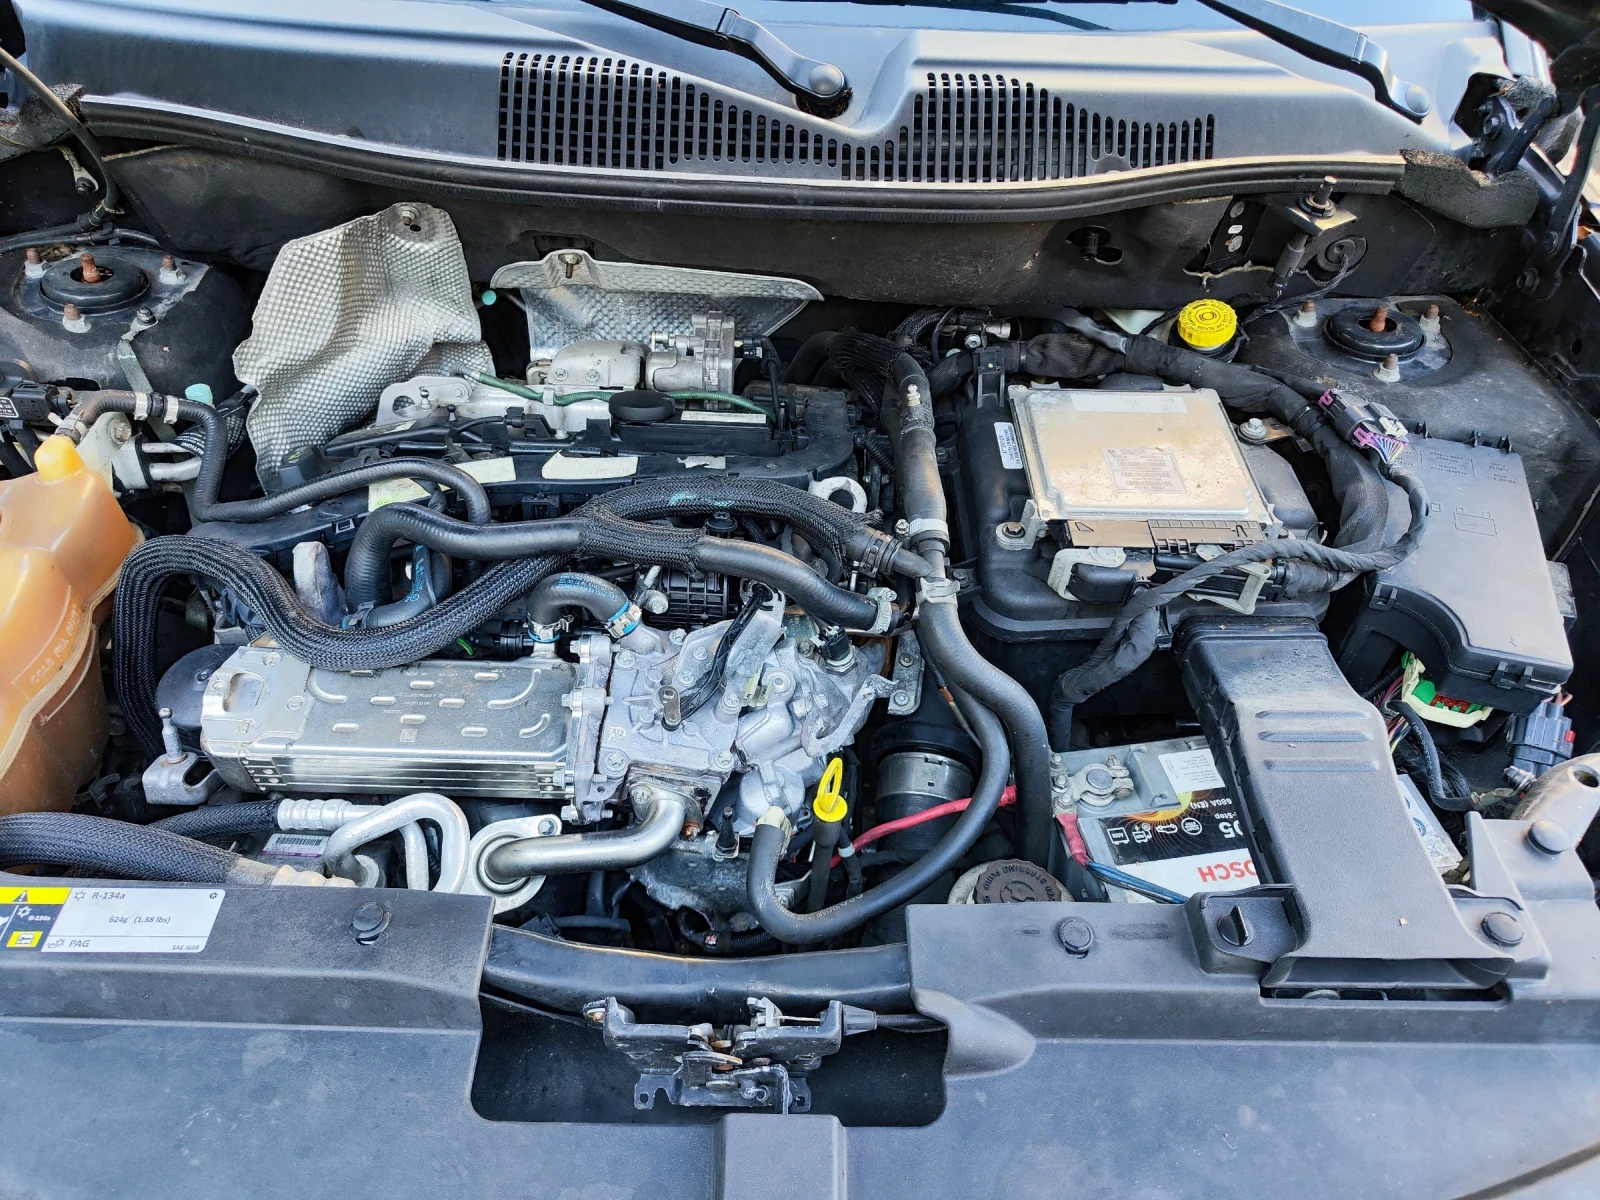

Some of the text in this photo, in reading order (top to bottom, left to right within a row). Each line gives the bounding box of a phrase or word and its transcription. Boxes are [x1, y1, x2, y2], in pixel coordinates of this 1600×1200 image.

[1190, 798, 1232, 810] 680A (EN)
[1198, 860, 1258, 882] OSCH
[92, 892, 125, 900] R-134a
[108, 916, 170, 924] 624g (1.38 lbs)
[68, 940, 91, 948] PAG
